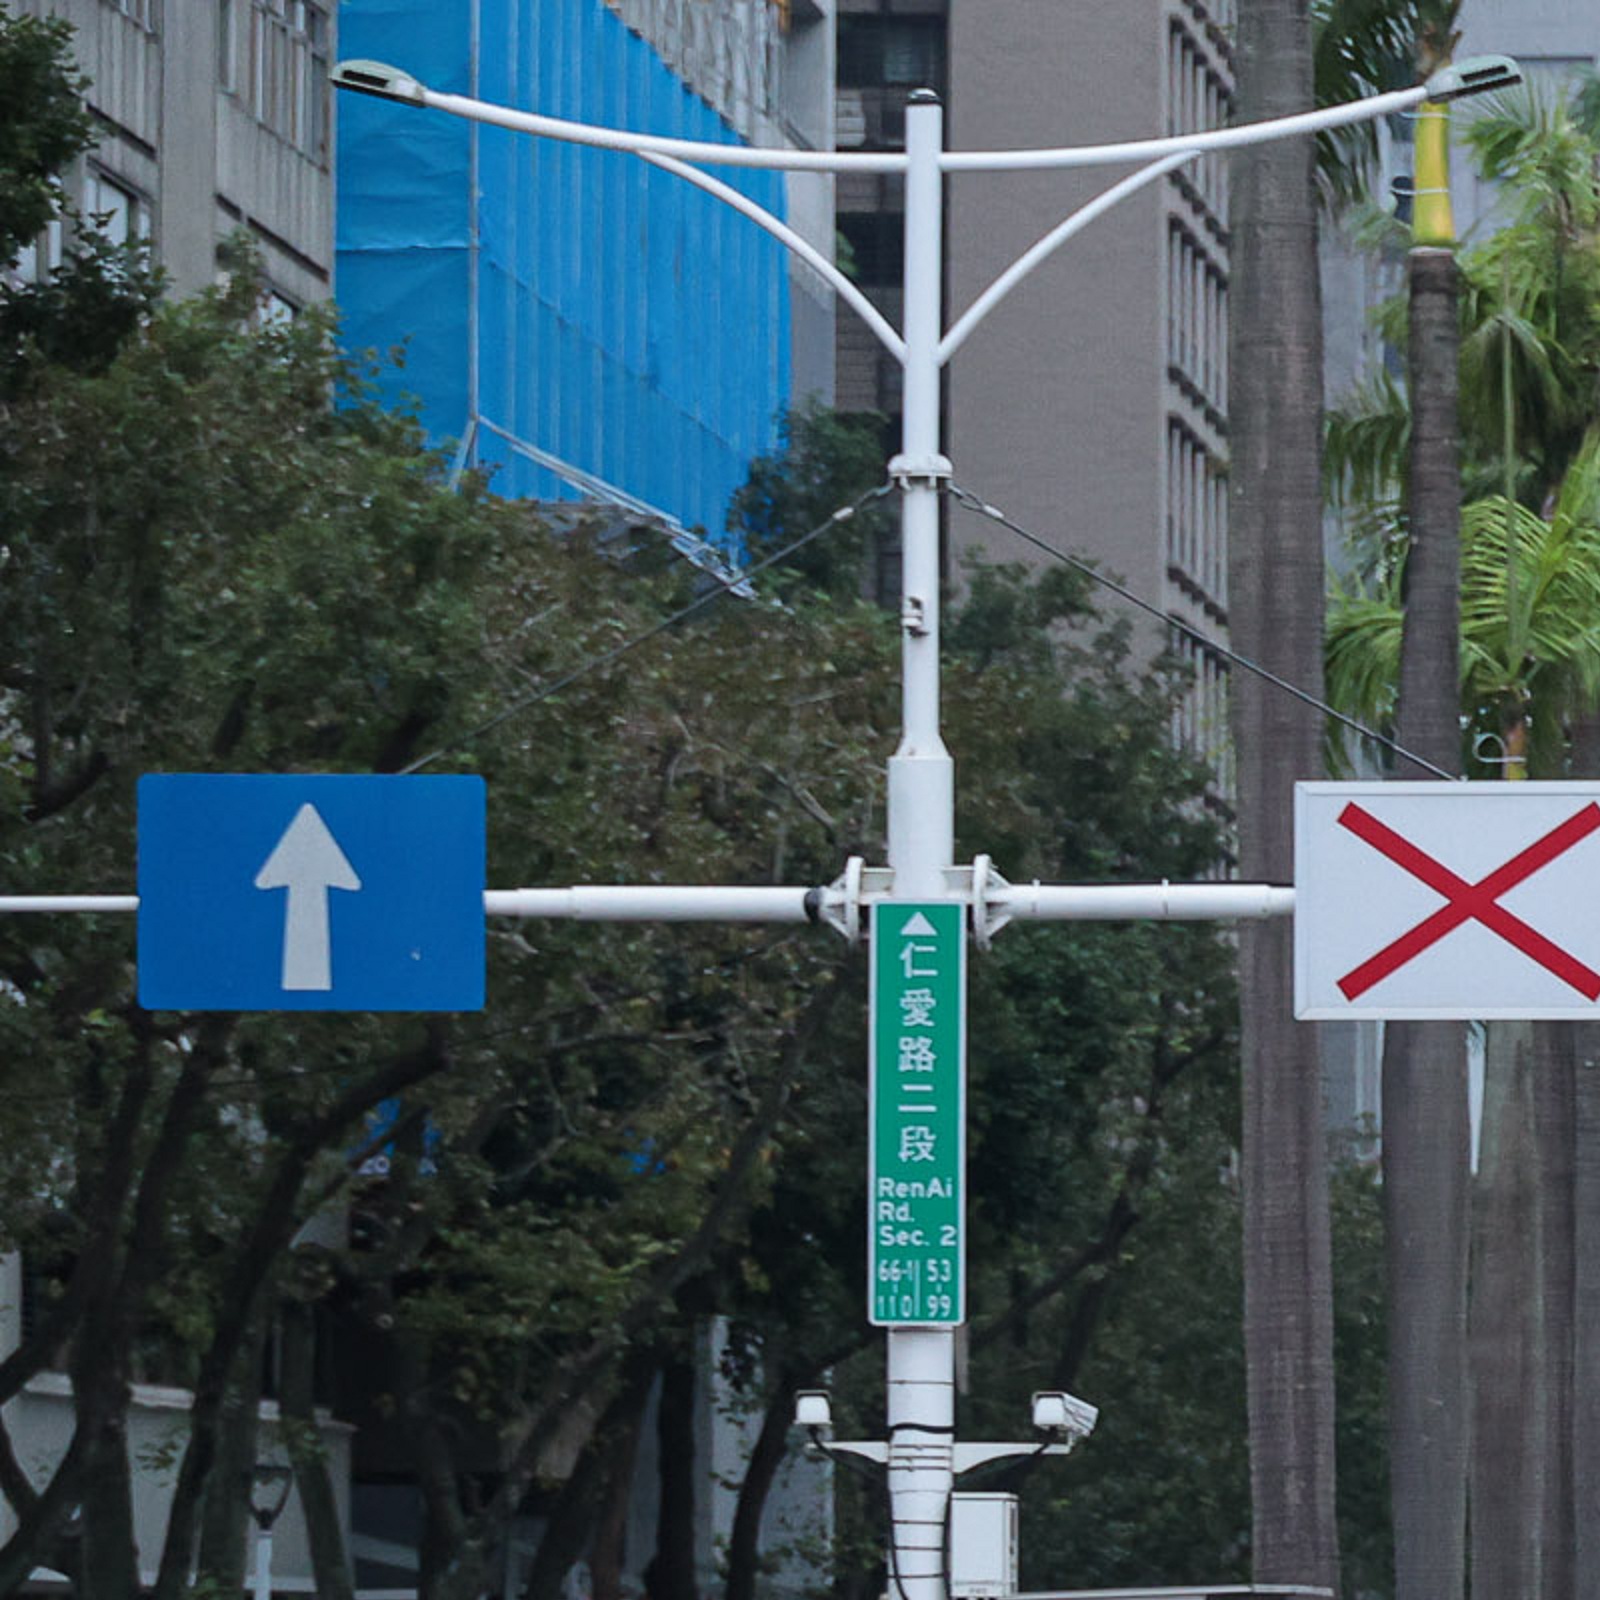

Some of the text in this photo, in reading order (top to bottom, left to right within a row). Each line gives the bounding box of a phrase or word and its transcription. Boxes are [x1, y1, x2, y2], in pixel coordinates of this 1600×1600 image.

[898, 941, 938, 1163] 仁愛路二段
[877, 1177, 953, 1199] RenAi
[877, 1201, 915, 1223] Rd.
[879, 1225, 957, 1247] Sec. 2
[926, 1258, 951, 1282] 53
[877, 1295, 951, 1318] 110 99
